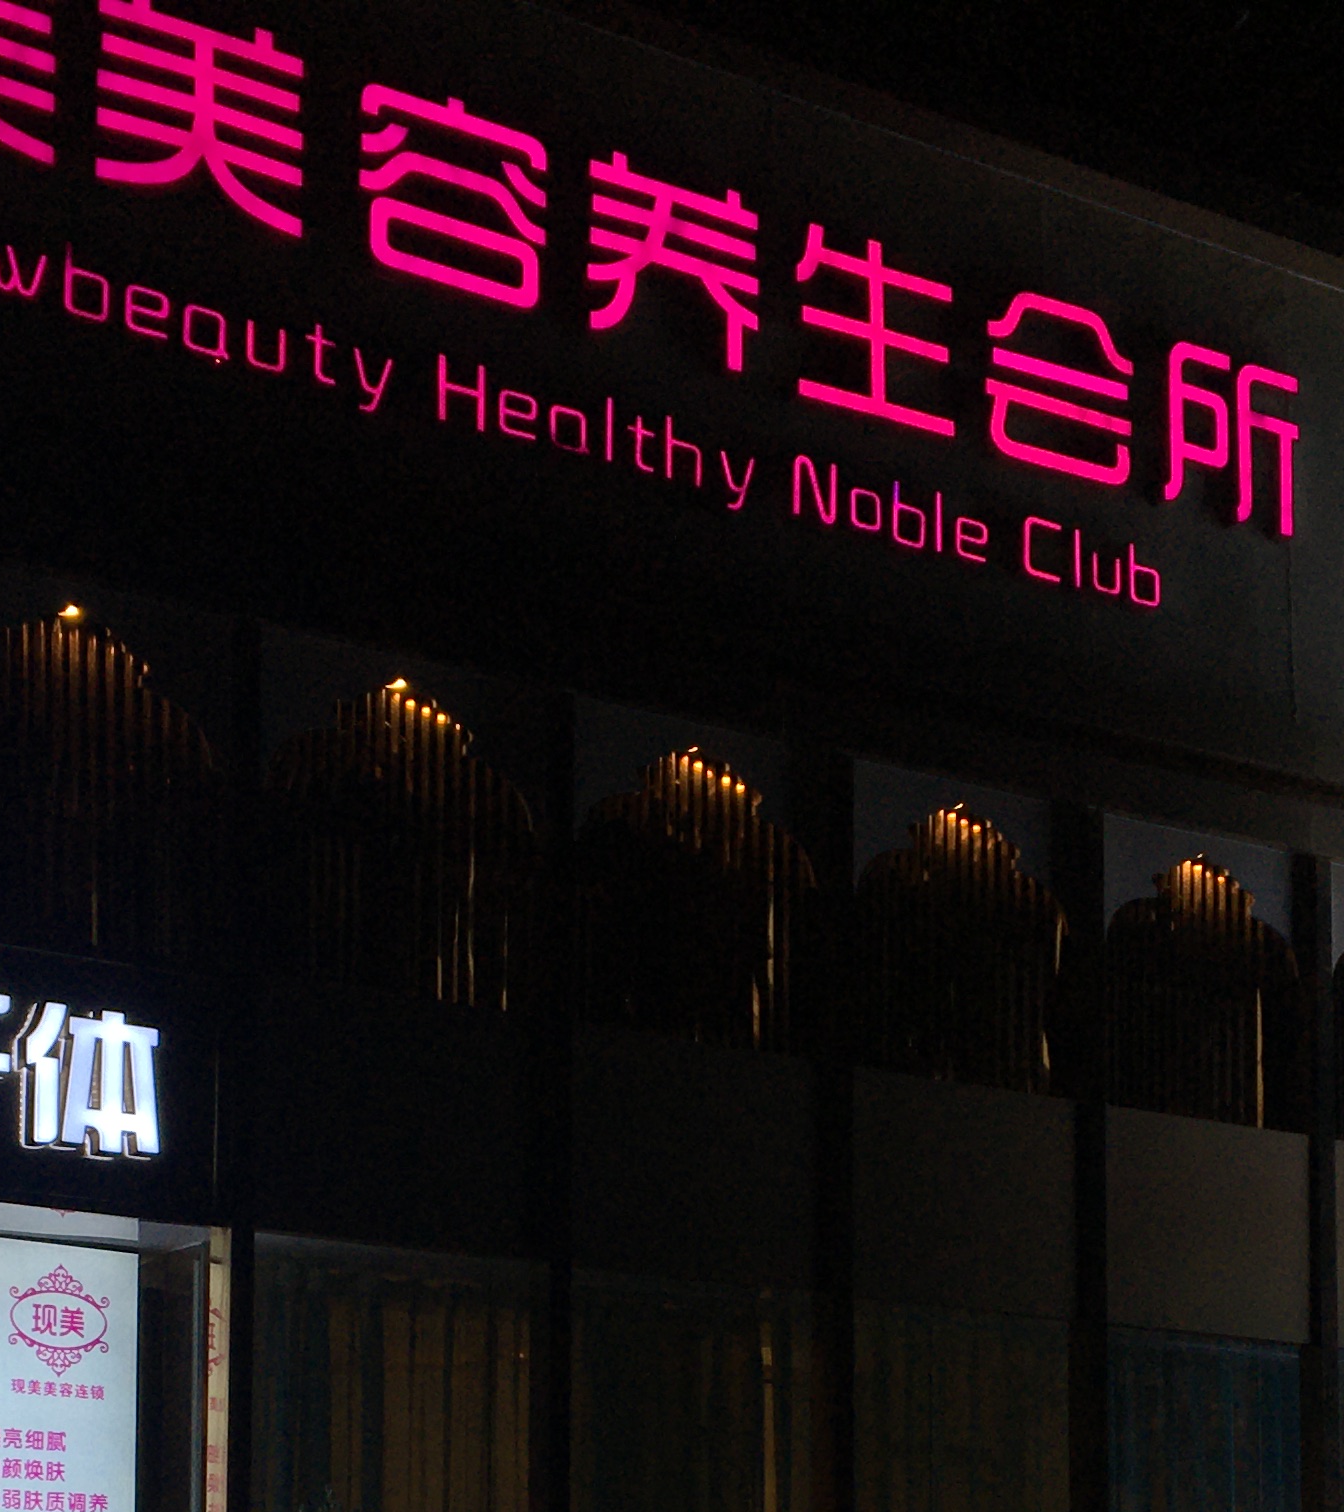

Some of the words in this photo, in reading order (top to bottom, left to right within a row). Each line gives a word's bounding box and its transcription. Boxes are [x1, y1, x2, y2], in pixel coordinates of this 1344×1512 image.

[436, 353, 754, 511] Healthy
[792, 454, 989, 562] Noble
[1022, 516, 1161, 607] Club
[31, 1303, 86, 1338] 现美
[10, 1377, 105, 1401] 现美美容连锁
